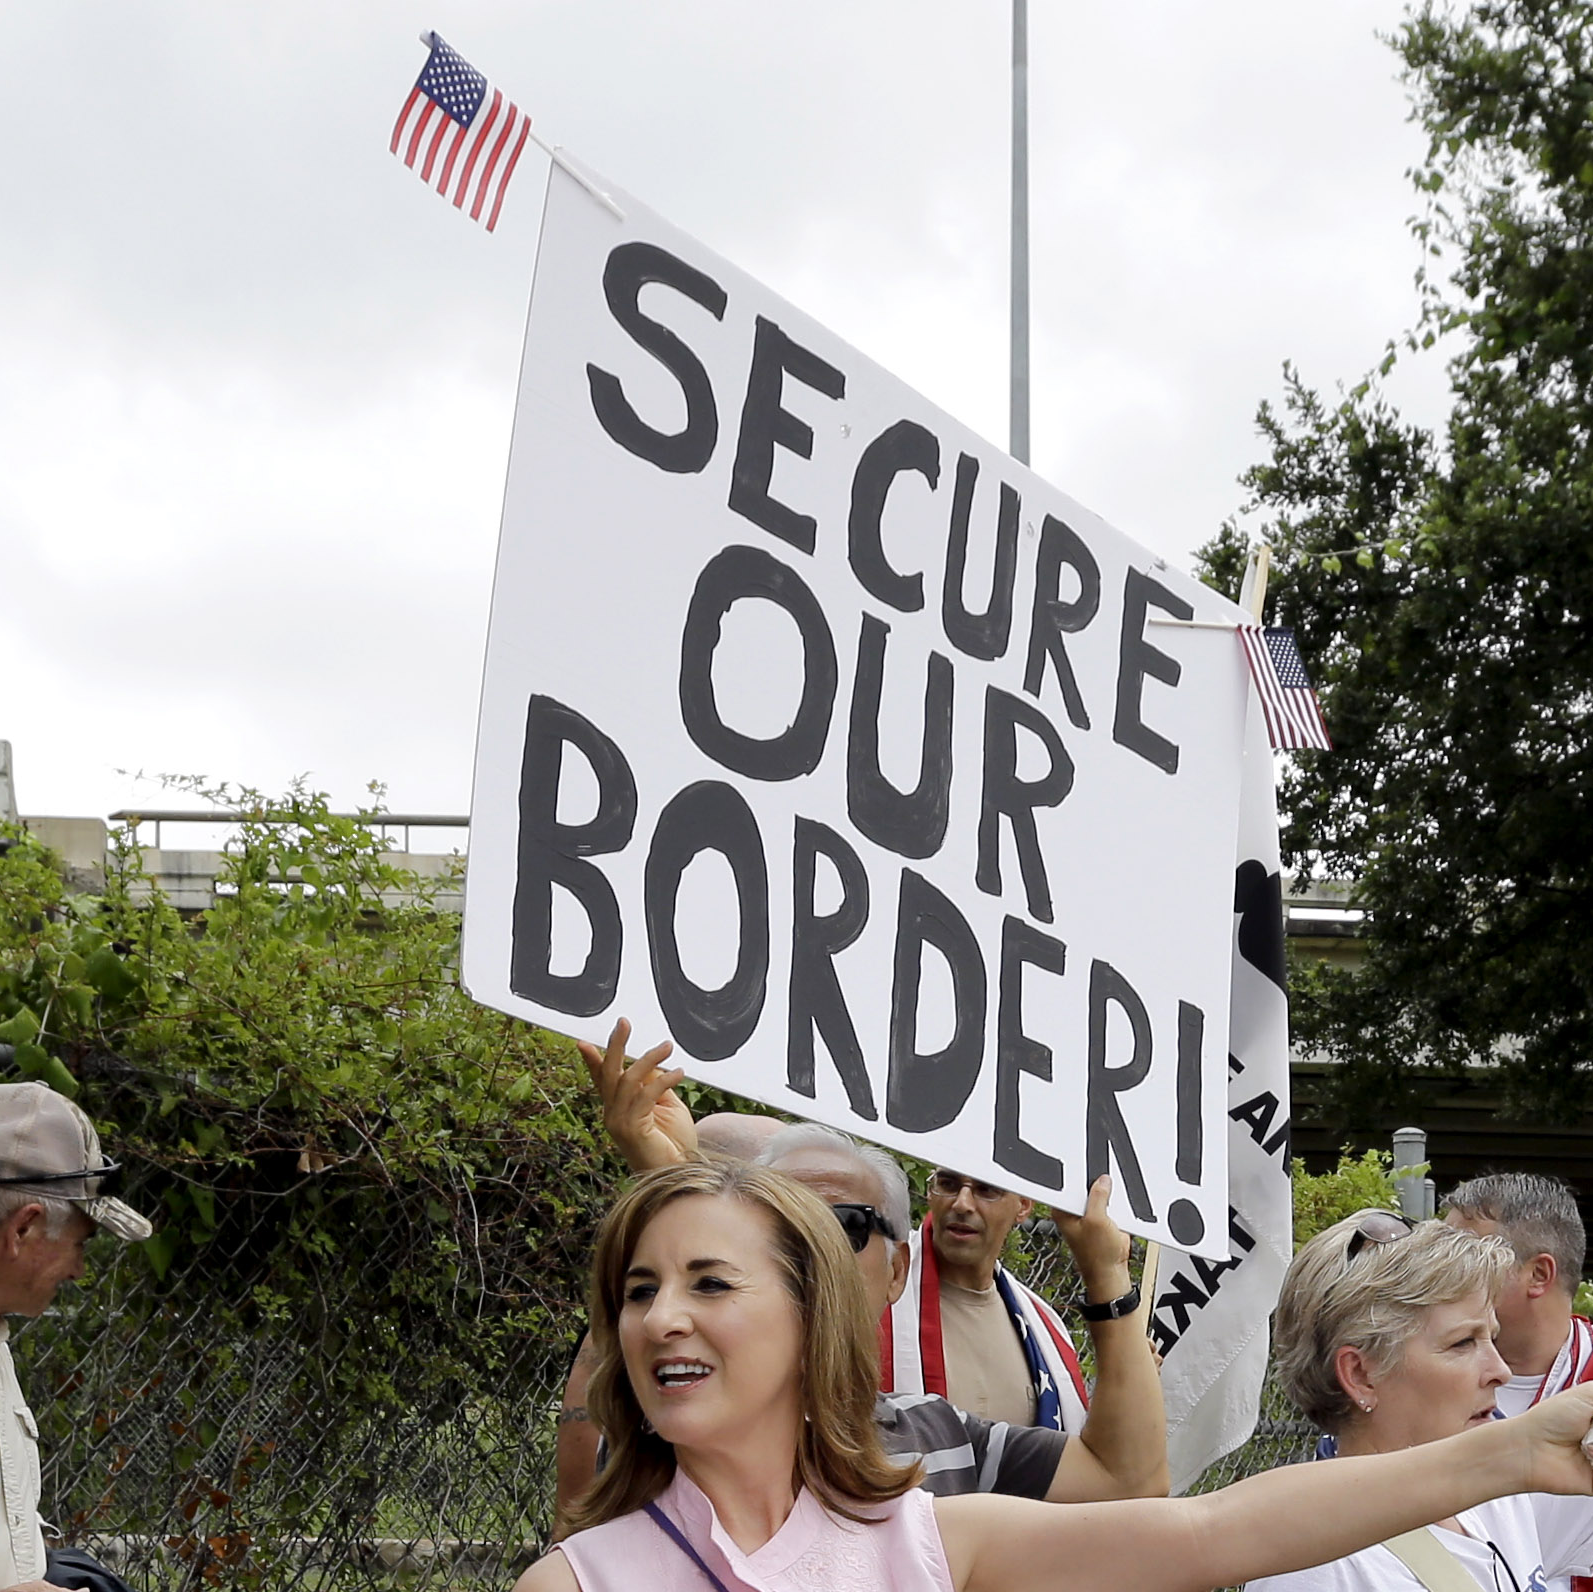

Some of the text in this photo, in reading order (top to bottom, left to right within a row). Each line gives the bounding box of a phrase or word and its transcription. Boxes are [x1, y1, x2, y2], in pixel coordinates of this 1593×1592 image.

[587, 240, 1194, 774] SECURE
[679, 544, 1074, 923] OUR
[509, 693, 1205, 1246] BORDER!
